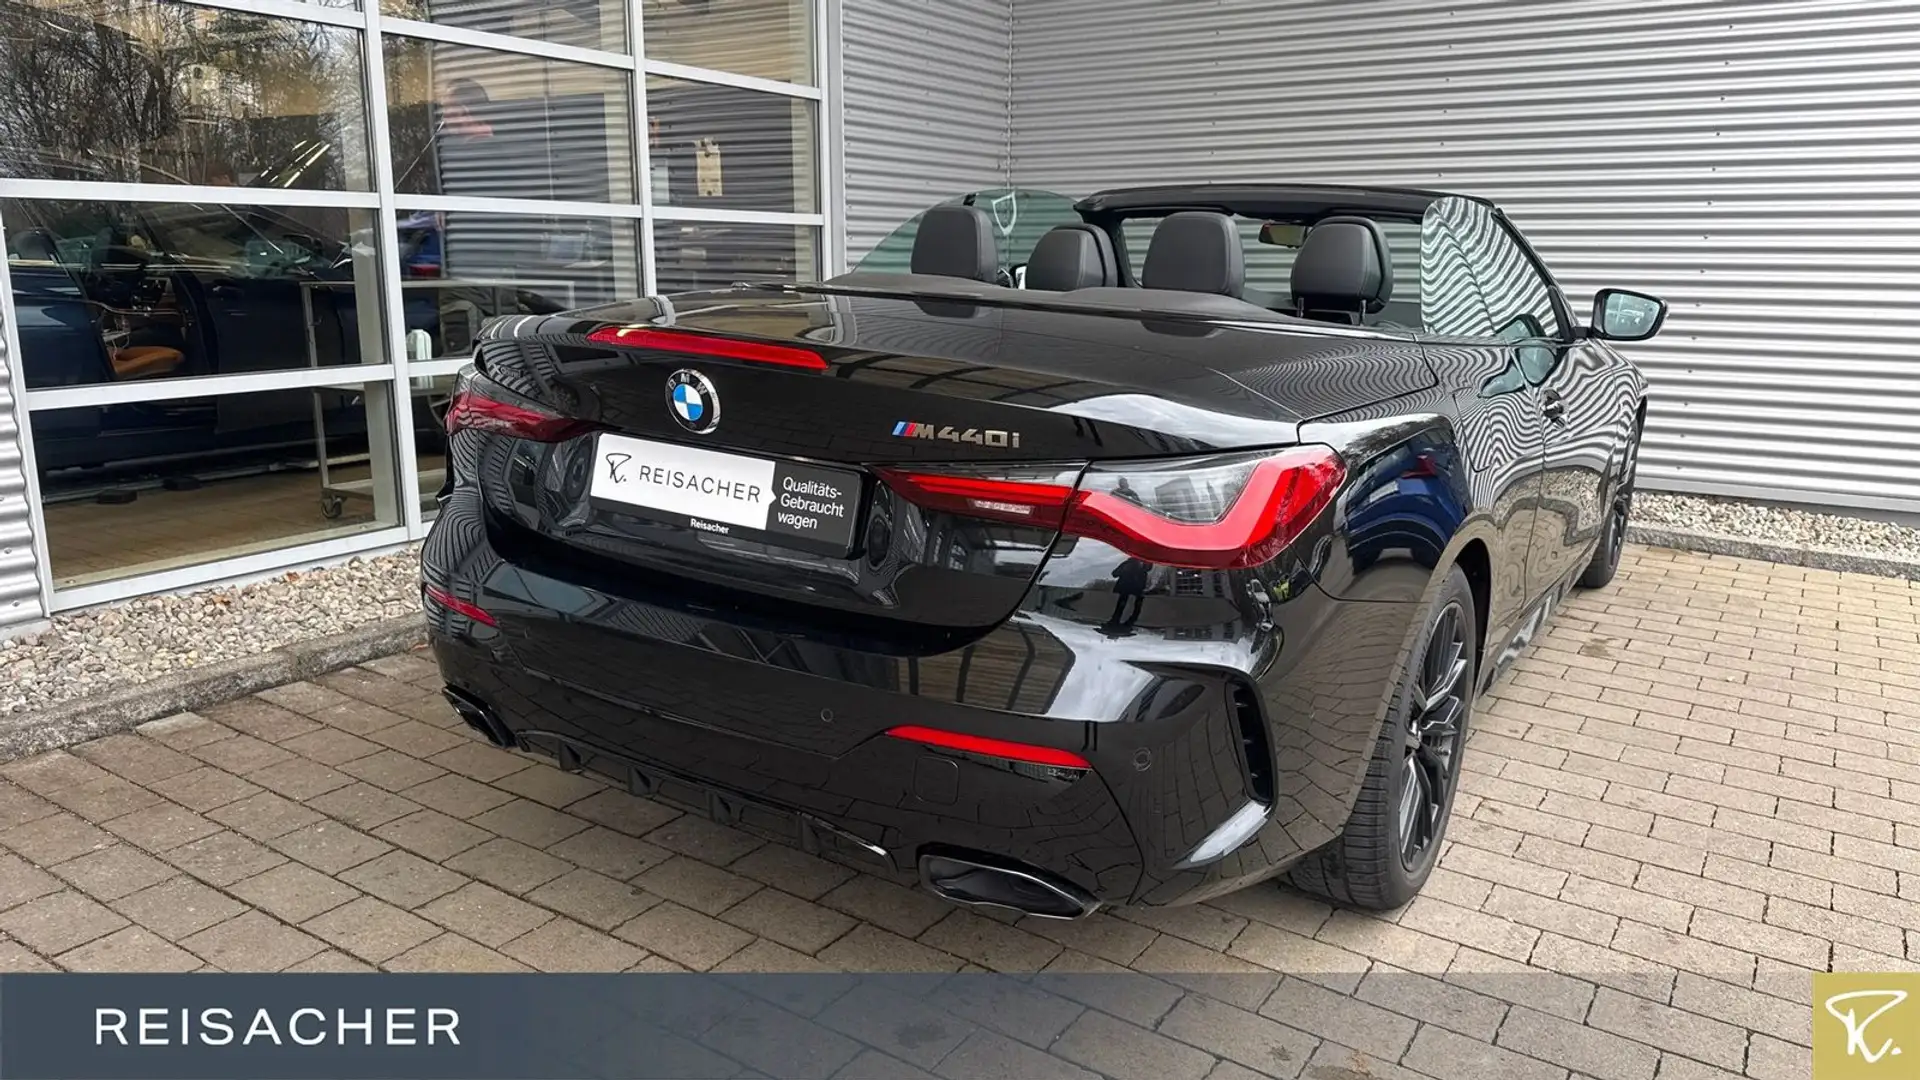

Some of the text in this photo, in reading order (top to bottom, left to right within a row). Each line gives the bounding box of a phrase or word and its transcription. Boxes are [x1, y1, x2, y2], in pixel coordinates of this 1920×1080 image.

[668, 373, 708, 395] BMW
[912, 423, 1020, 448] M440i
[639, 465, 761, 503] REISACHER
[782, 476, 843, 499] Qualitäts-
[780, 492, 845, 518] Gebraucht
[690, 518, 730, 534] Reisacher
[777, 512, 818, 530] wagen
